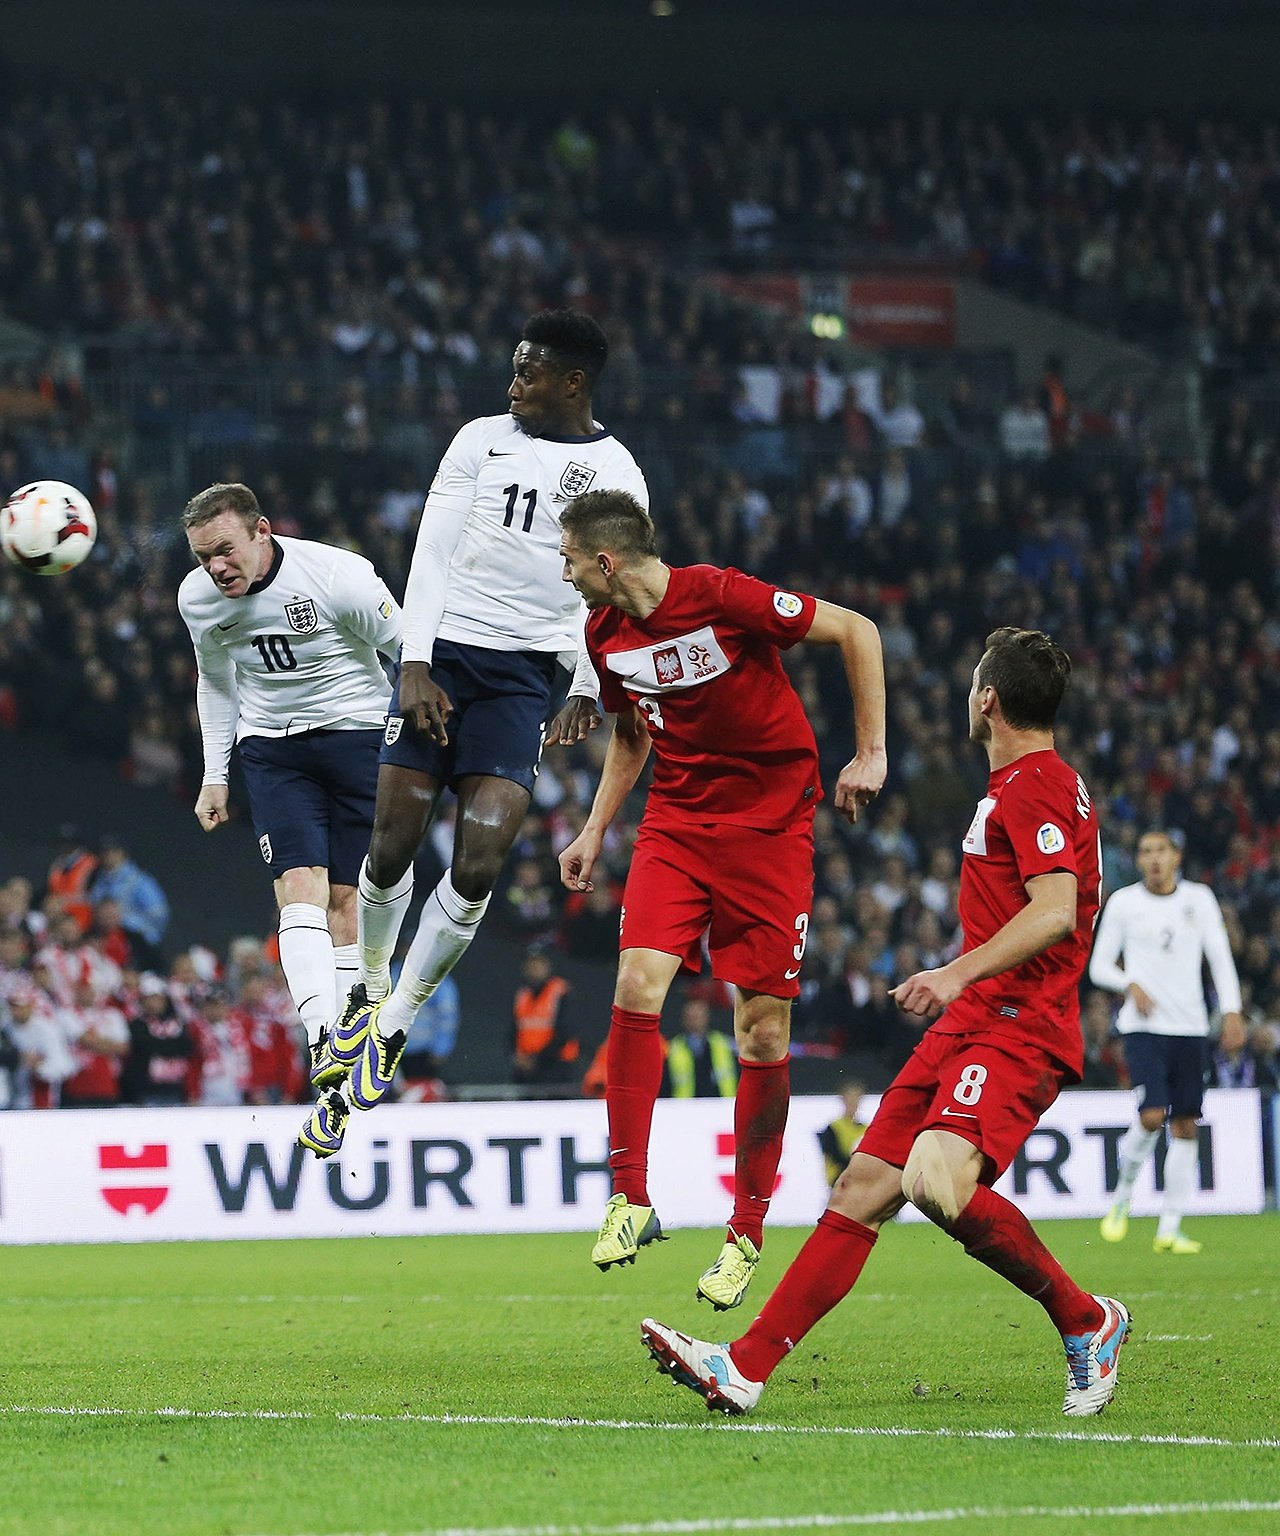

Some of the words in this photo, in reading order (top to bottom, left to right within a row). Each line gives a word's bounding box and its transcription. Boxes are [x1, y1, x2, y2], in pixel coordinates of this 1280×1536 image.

[503, 483, 538, 533] 11
[250, 634, 298, 672] 10
[693, 664, 719, 680] POLSKA
[793, 912, 810, 961] 3
[952, 1063, 988, 1106] 8
[204, 1136, 615, 1211] WÜRTH
